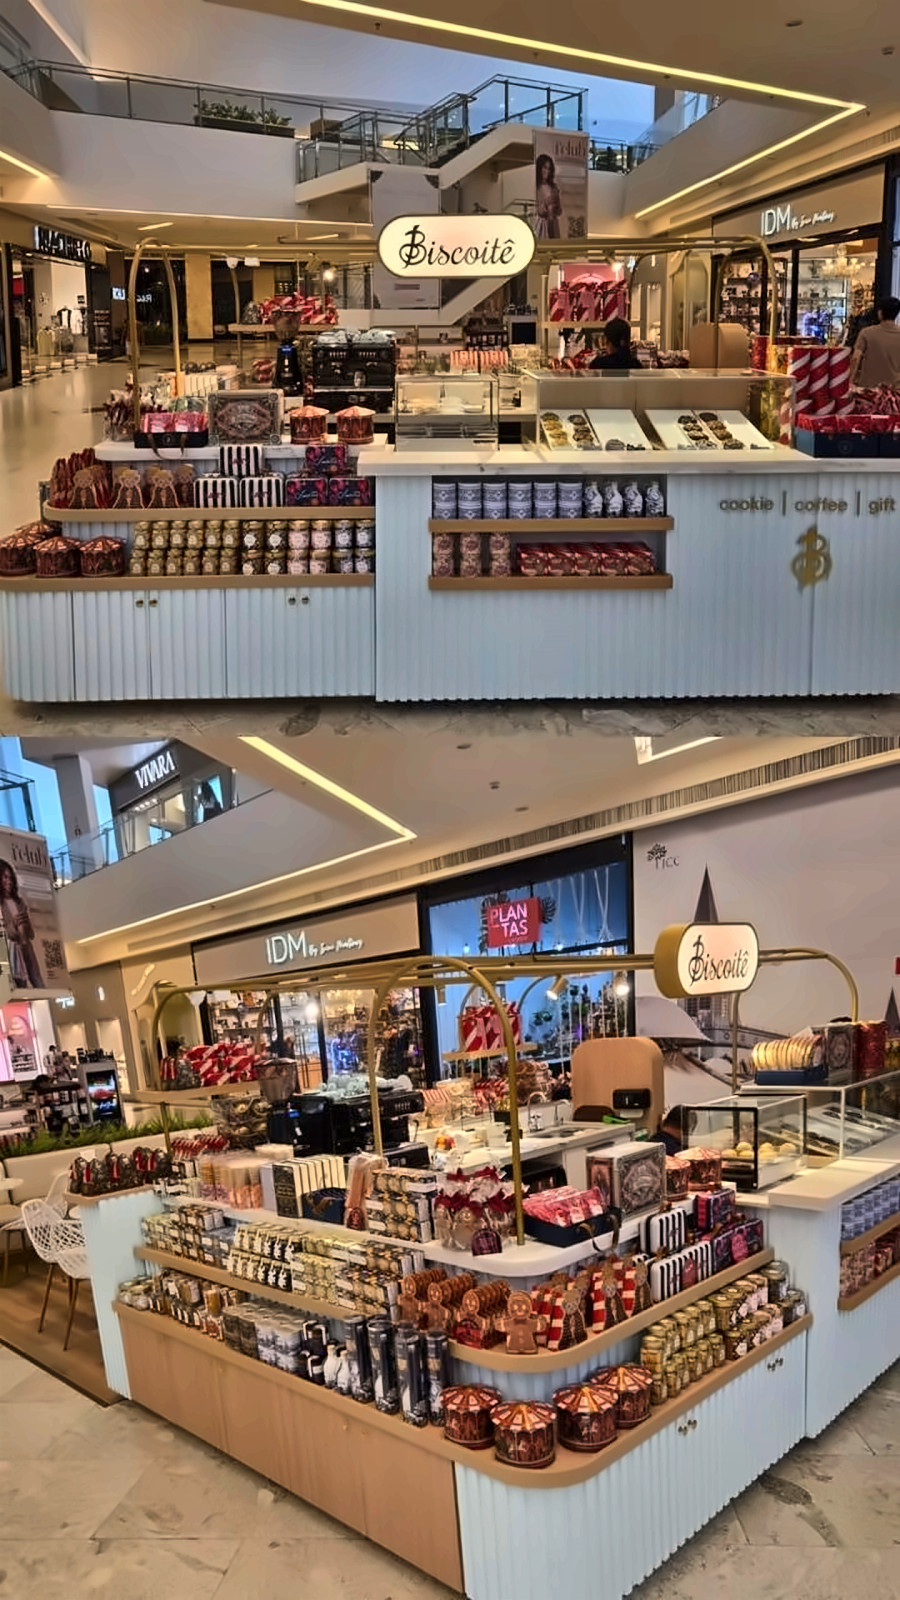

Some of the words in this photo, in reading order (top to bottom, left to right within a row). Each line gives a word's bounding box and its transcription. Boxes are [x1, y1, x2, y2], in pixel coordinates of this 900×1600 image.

[760, 203, 791, 237] IDM
[399, 224, 516, 270] Biscoitê
[719, 496, 775, 512] cookie
[794, 497, 848, 513] coffee
[868, 497, 896, 515] gift
[134, 750, 176, 789] VIVARA
[489, 902, 528, 926] PLAN
[500, 919, 529, 938] TAS
[265, 929, 308, 965] IDM
[689, 934, 749, 987] Biscoitê
